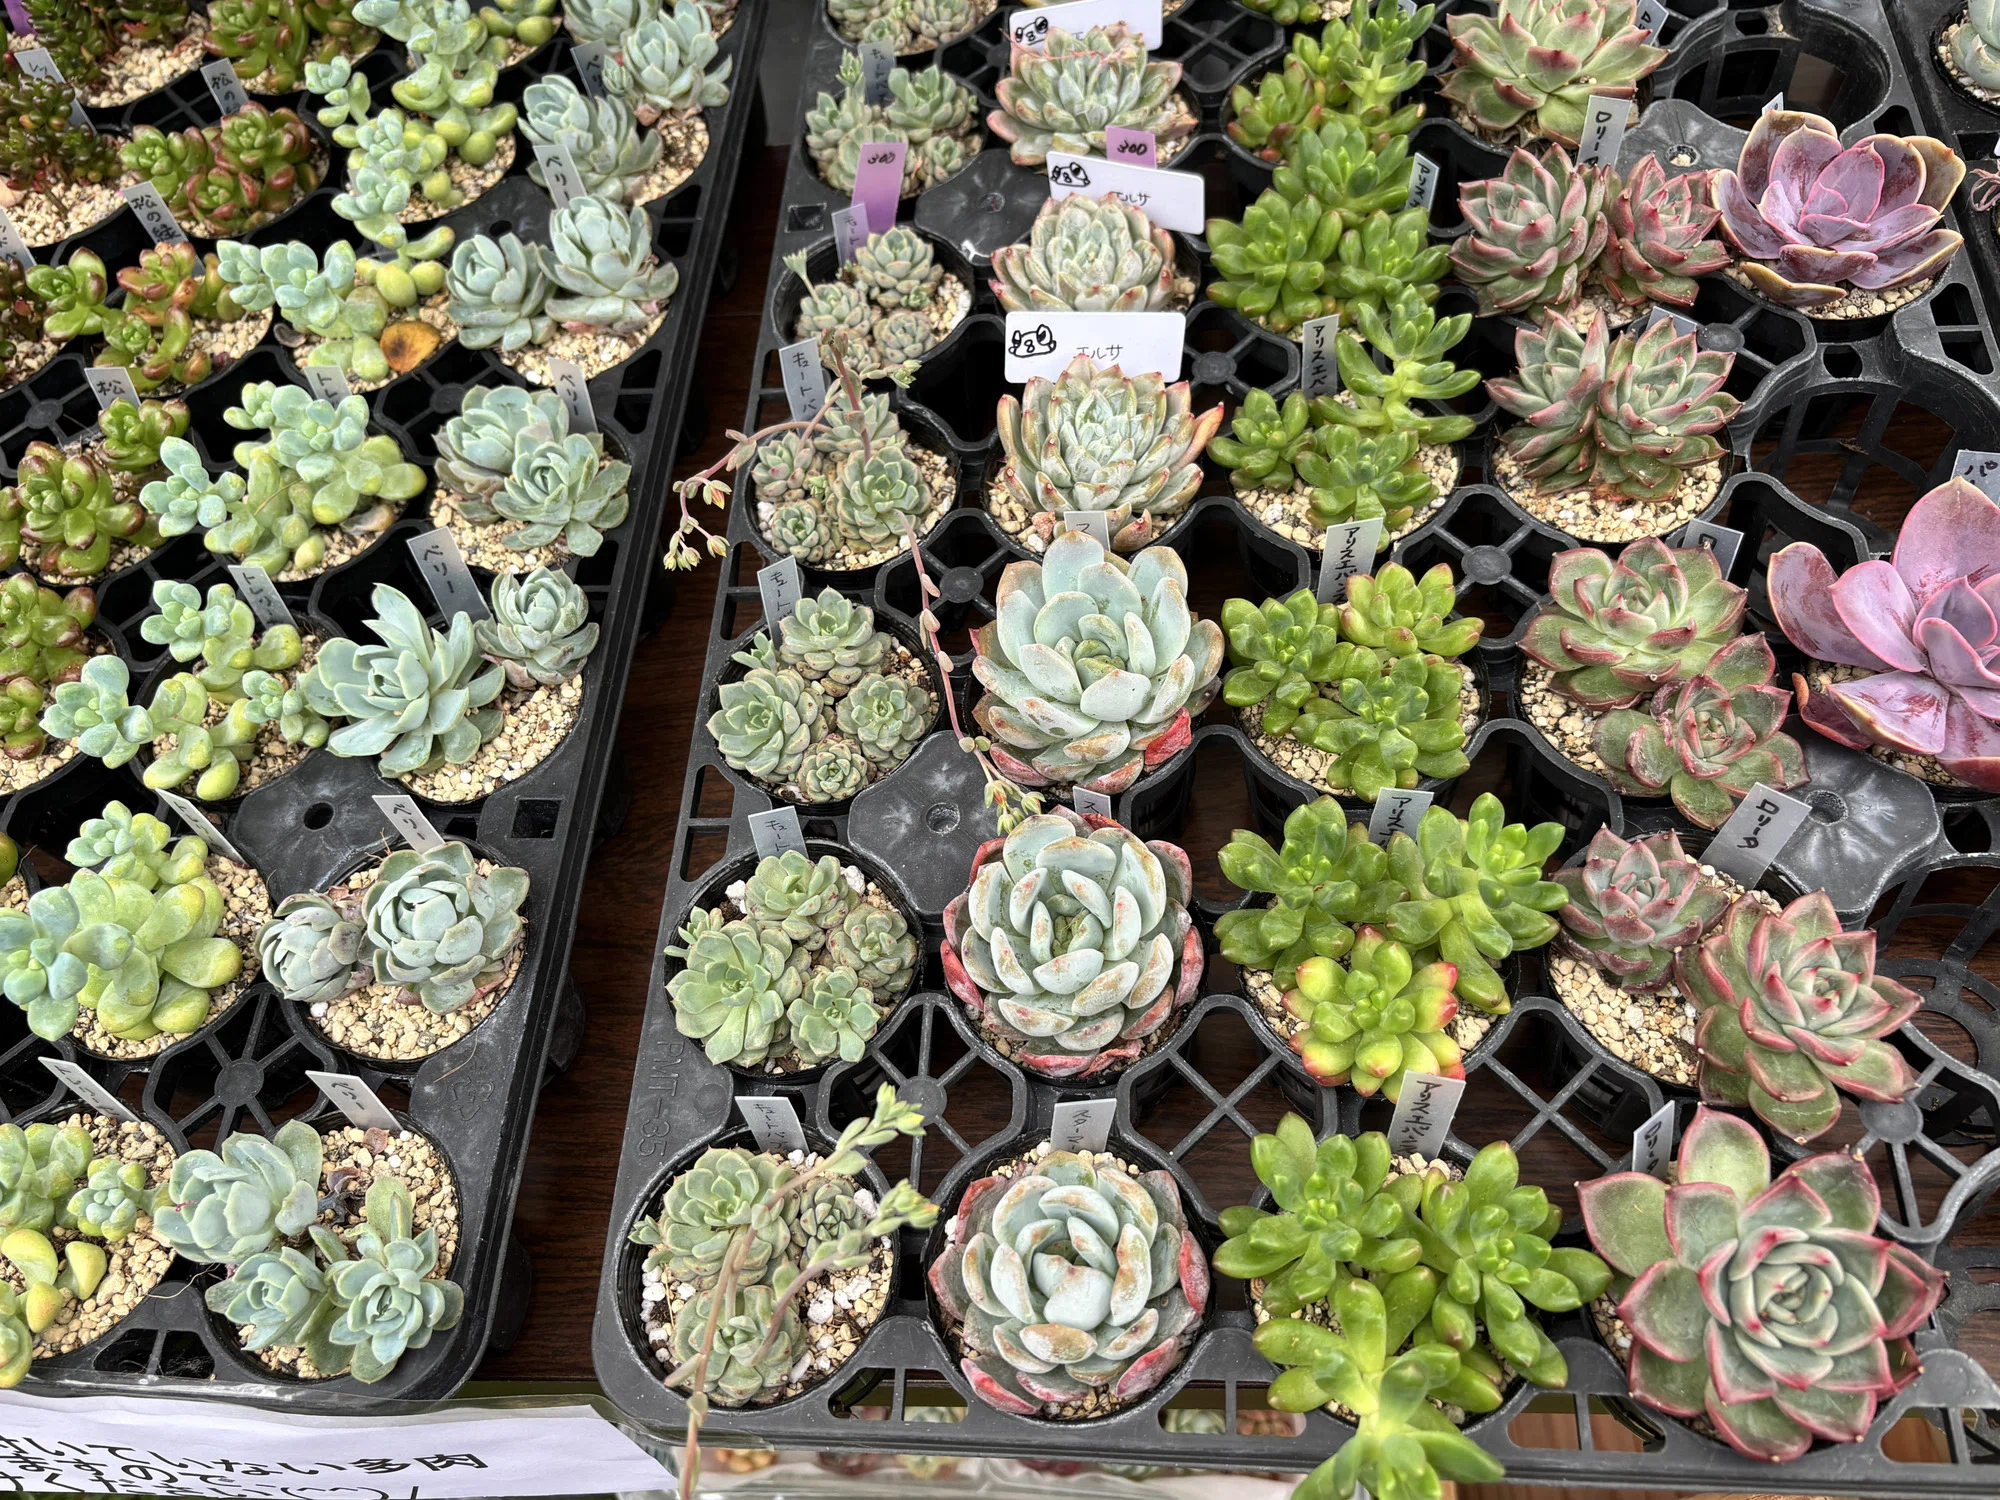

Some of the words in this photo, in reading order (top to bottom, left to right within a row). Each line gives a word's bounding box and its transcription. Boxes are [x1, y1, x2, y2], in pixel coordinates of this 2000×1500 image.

[867, 152, 895, 164] 300
[1117, 142, 1147, 156] 300
[546, 156, 570, 201] ベリー
[97, 380, 126, 396] 松
[317, 373, 339, 408] トレ
[560, 373, 580, 416] ベリー
[424, 545, 455, 593] ベリー
[393, 802, 426, 841] ベリー
[1738, 798, 1781, 849] ロリータ
[331, 1081, 366, 1111] ベリー
[637, 1041, 685, 1157] PMT-35
